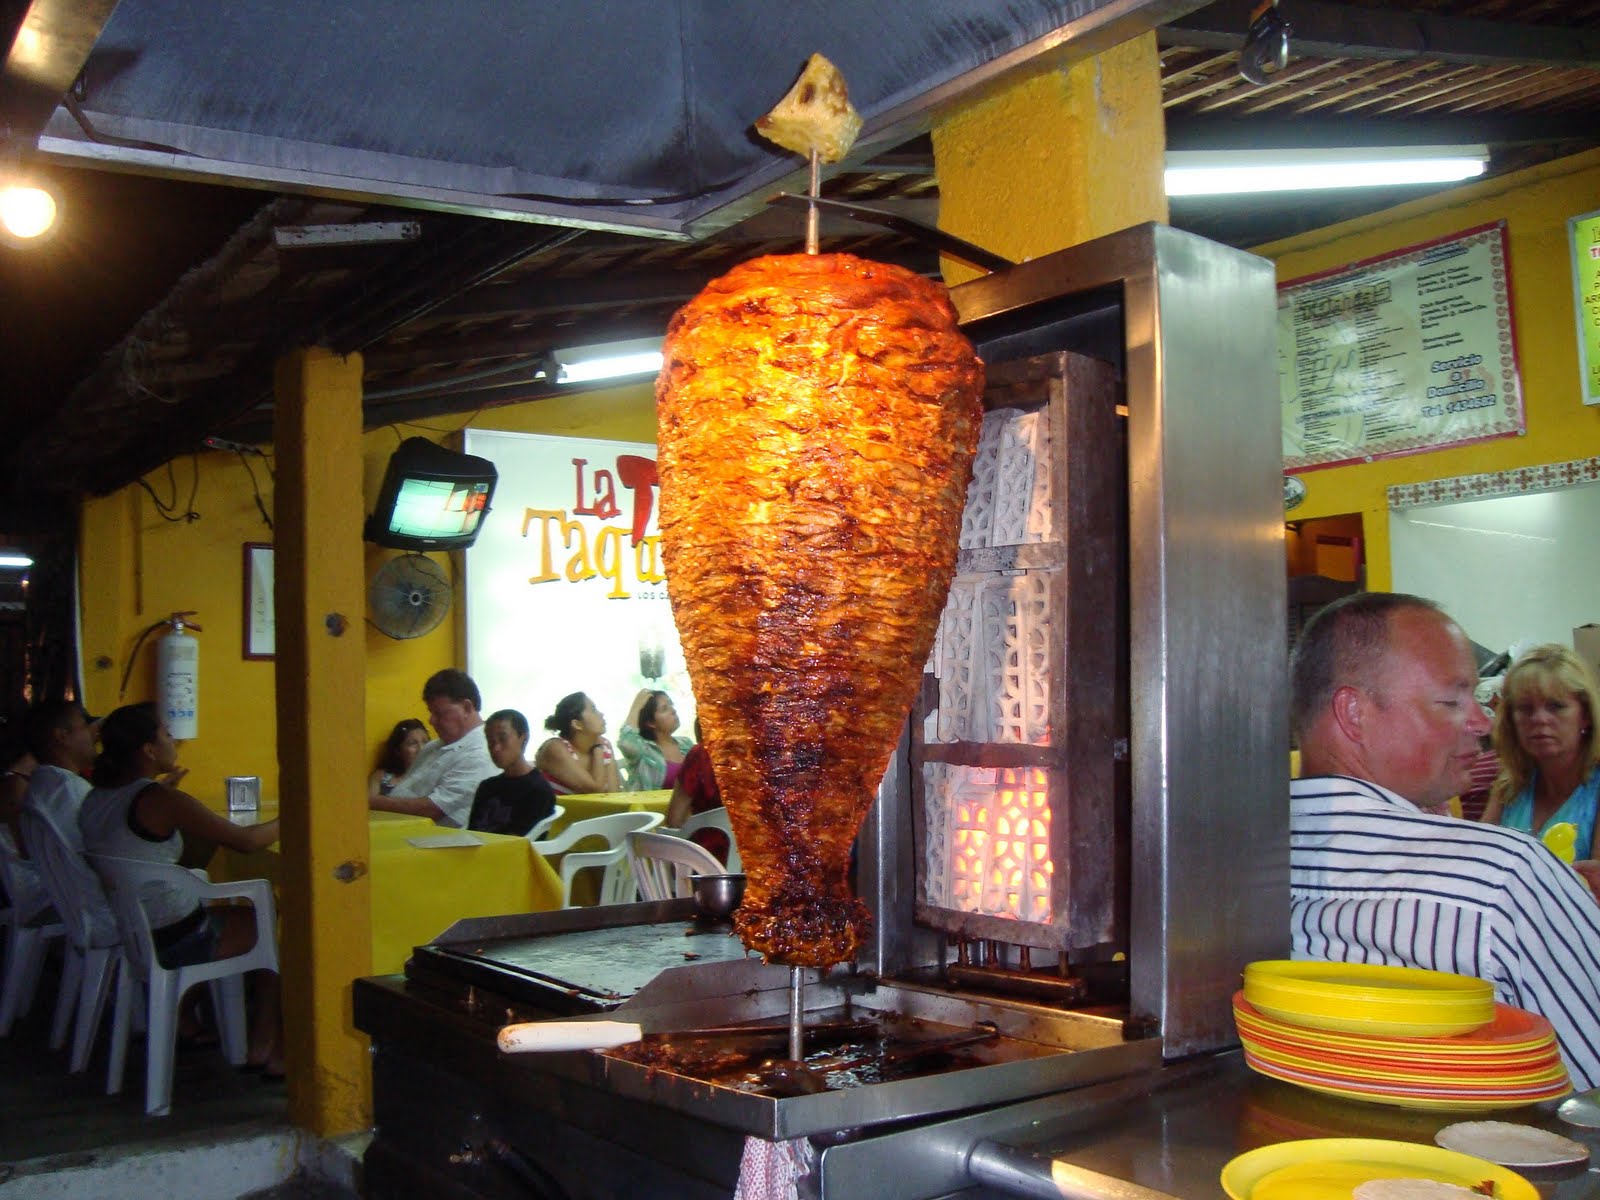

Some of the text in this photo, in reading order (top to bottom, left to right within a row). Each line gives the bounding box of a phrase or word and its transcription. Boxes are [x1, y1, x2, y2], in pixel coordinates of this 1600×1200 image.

[1431, 353, 1483, 373] Servicio
[1427, 378, 1485, 399] Domicilio
[572, 458, 622, 520] La
[522, 507, 668, 599] Taqu
[637, 591, 655, 600] LOS
